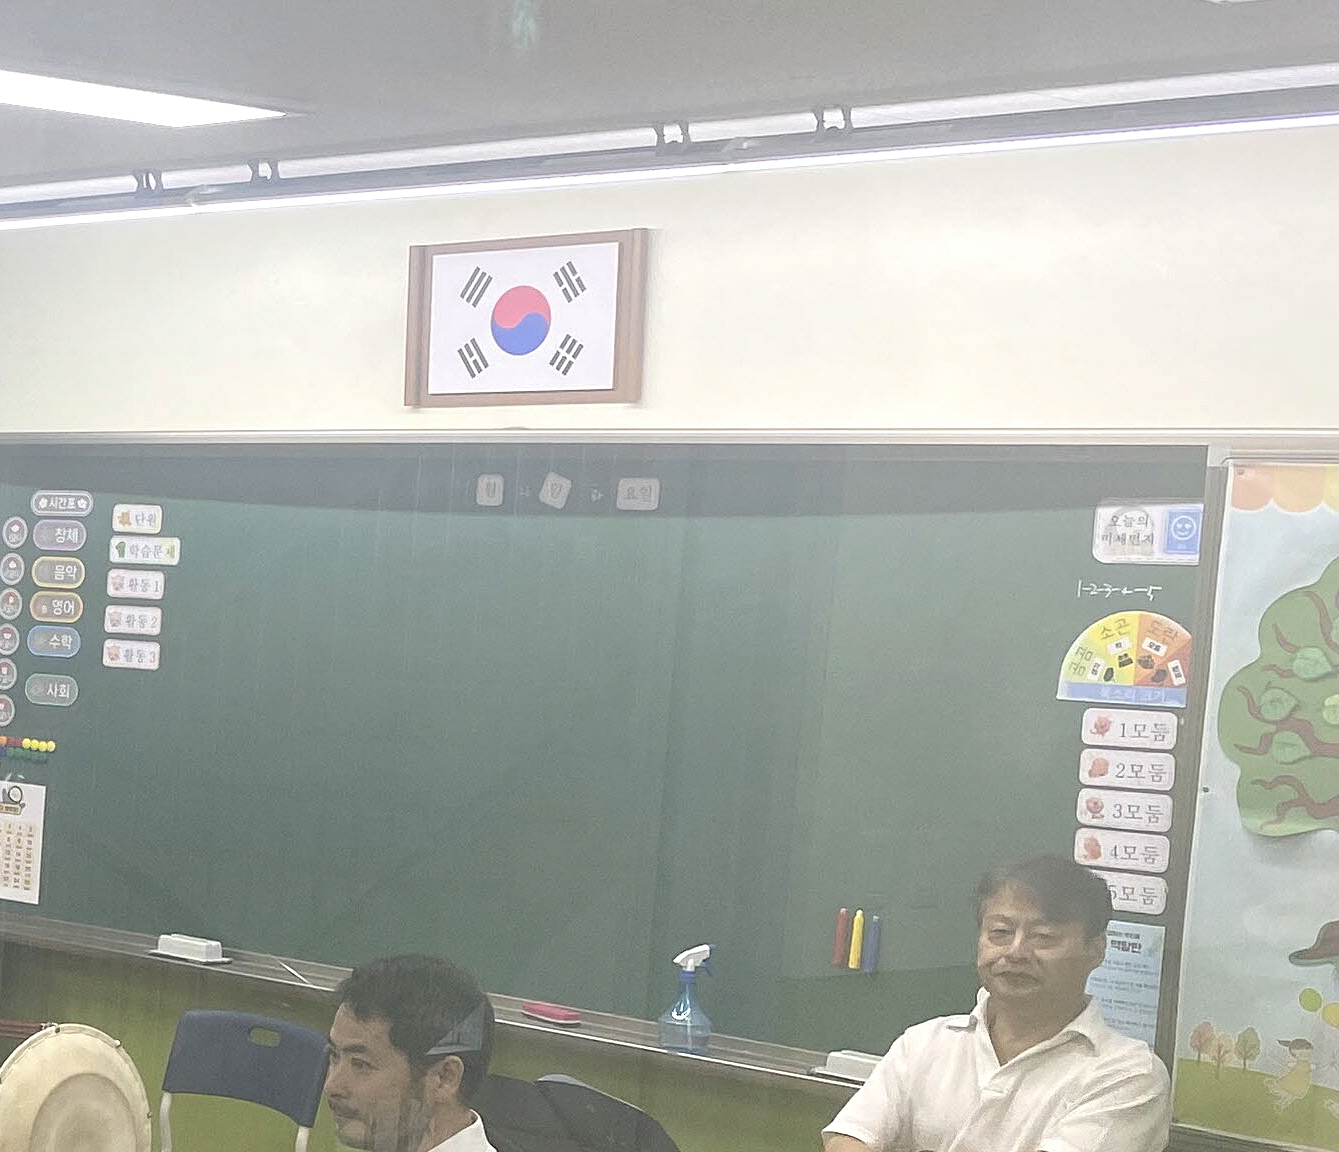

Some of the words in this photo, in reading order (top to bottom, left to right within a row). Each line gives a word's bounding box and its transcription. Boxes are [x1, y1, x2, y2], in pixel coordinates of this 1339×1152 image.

[48, 497, 77, 510] 시간표
[134, 511, 157, 524] 단원
[1109, 515, 1149, 528] 오늘의
[54, 527, 79, 544] 창체
[1101, 532, 1155, 546] 미세먼지
[54, 565, 78, 581] 음악
[51, 599, 76, 615] 영어
[1100, 618, 1130, 640] 소곤
[49, 634, 73, 651] 수학
[46, 683, 71, 699] 사회
[1119, 723, 1170, 742] 1모둠
[1115, 763, 1166, 783] 2모둠
[1112, 803, 1164, 824] 3모둠
[1110, 844, 1160, 865] 4모둠
